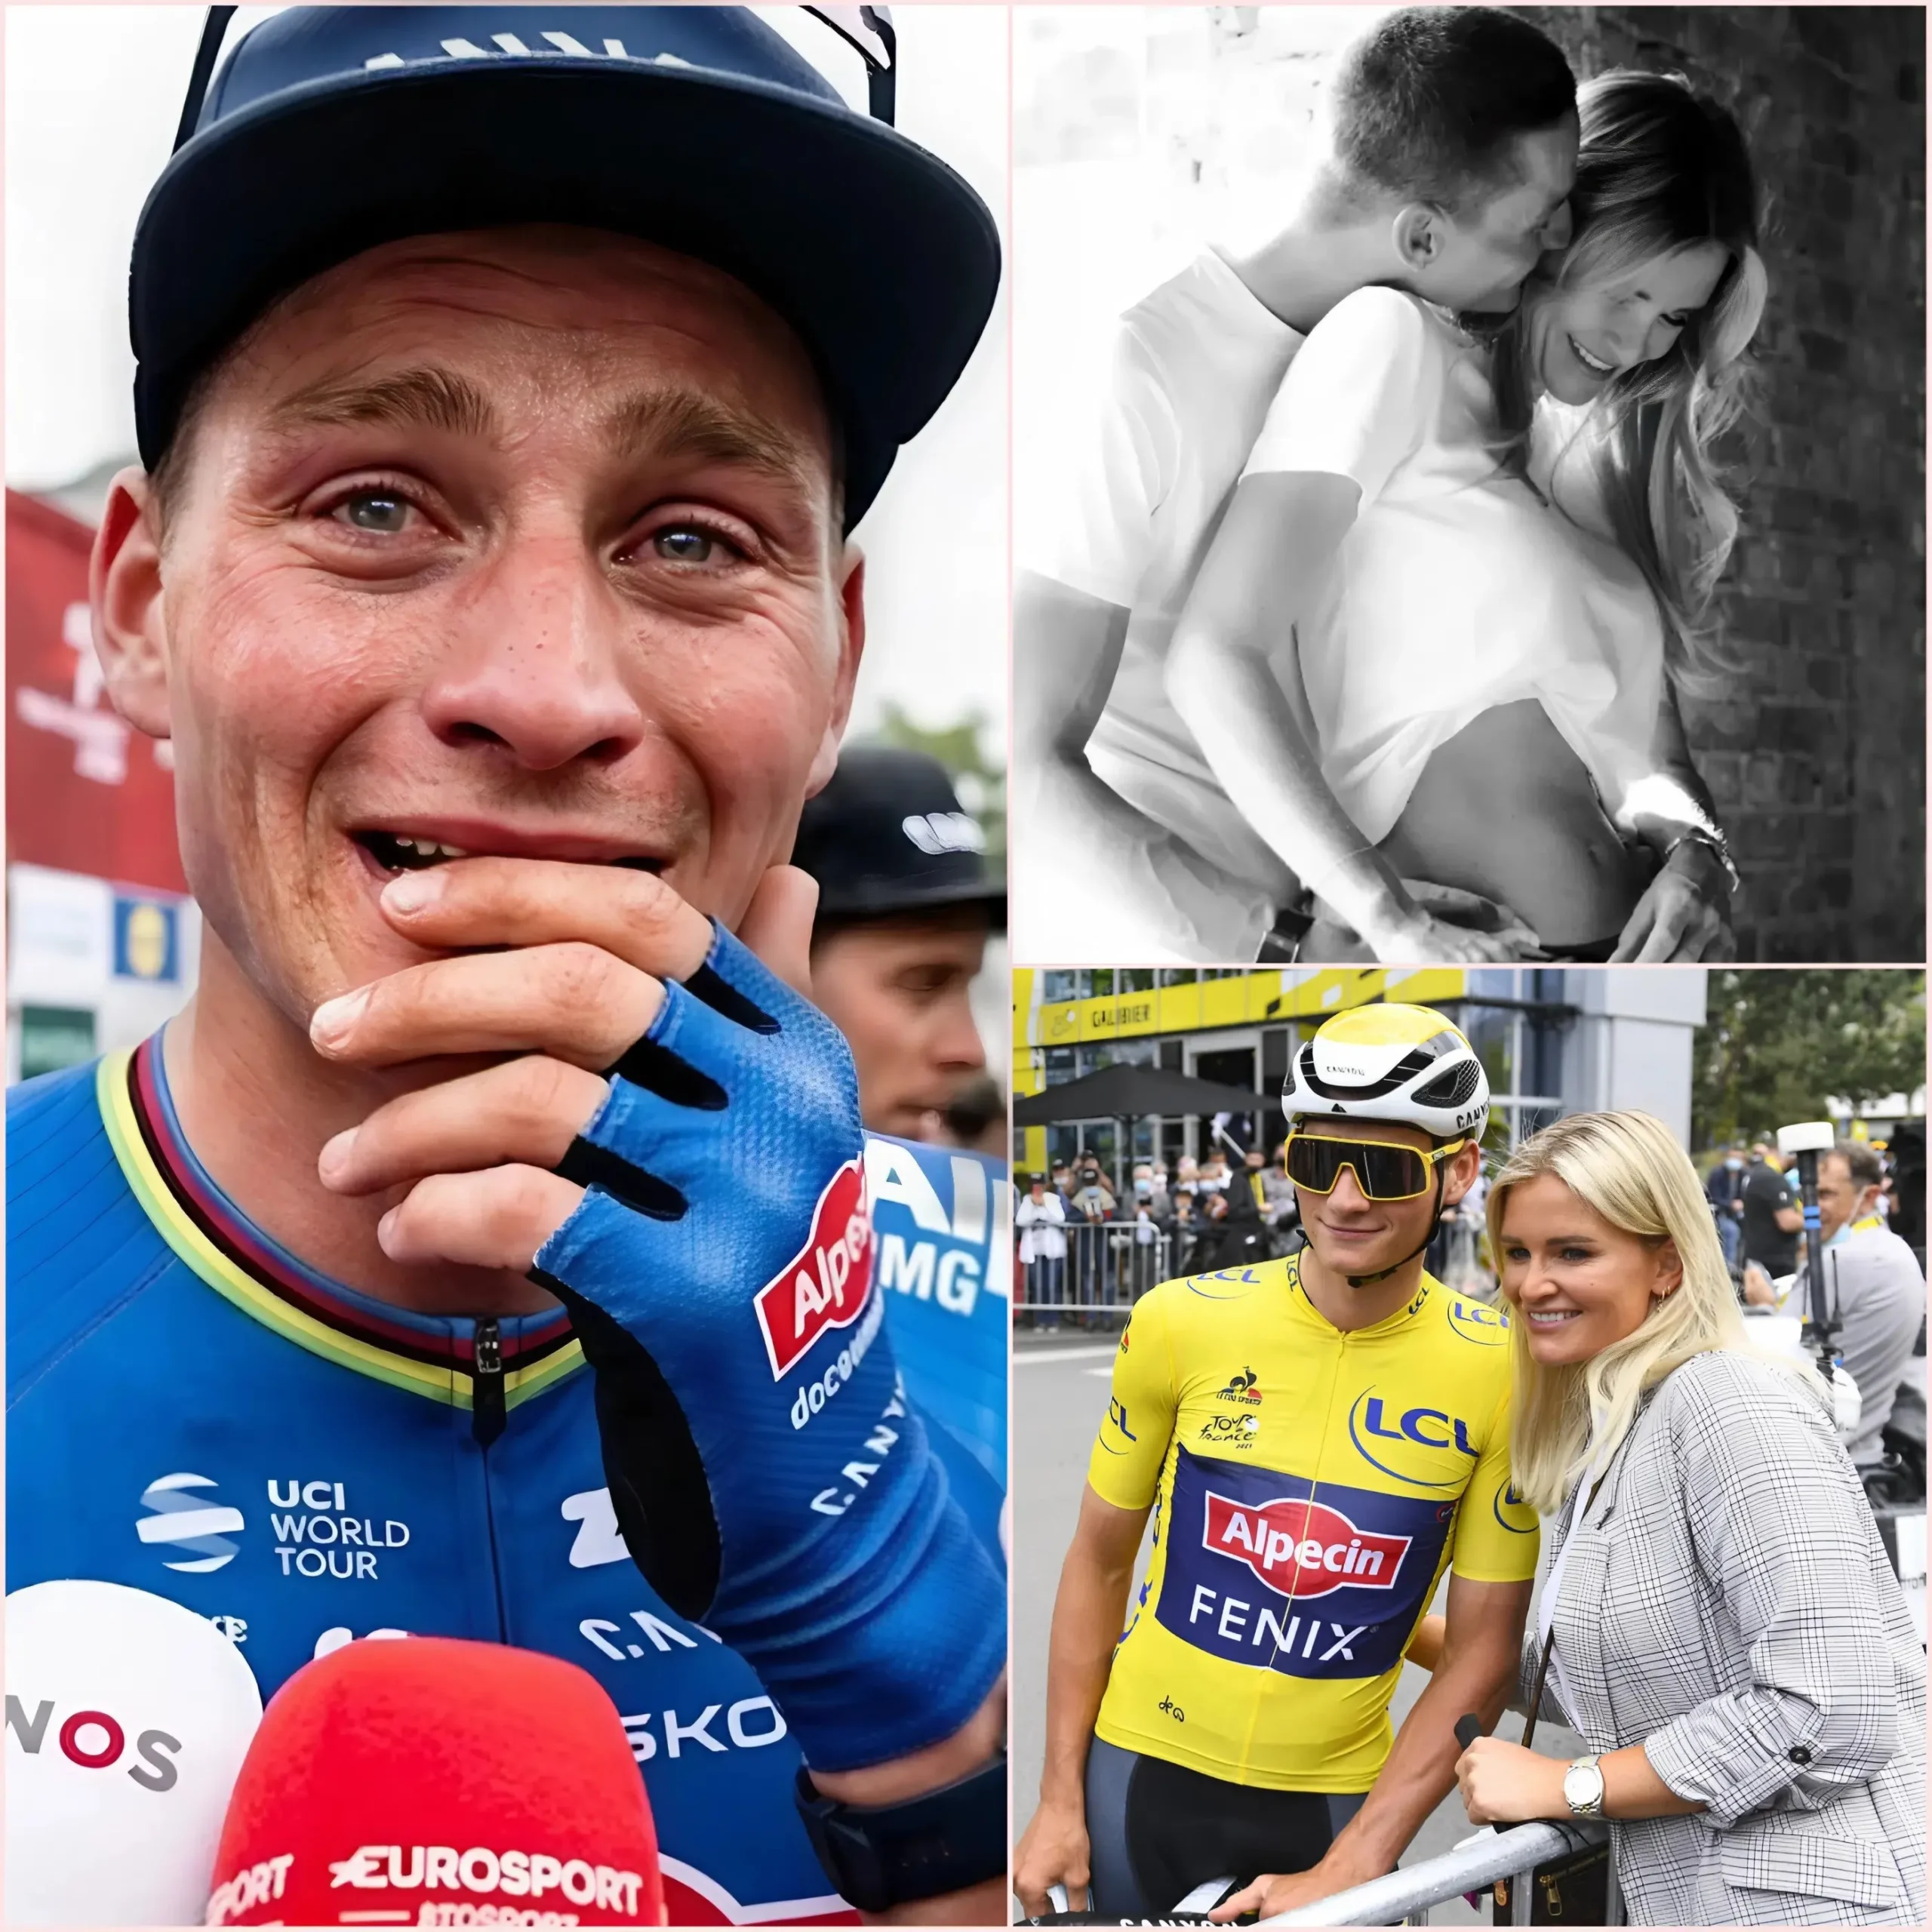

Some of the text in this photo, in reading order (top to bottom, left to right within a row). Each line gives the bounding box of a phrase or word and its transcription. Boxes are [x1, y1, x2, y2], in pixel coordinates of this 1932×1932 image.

[1364, 1397, 1480, 1458] LCL
[267, 1479, 346, 1511] UCI
[270, 1513, 411, 1548] WORLD
[1221, 1512, 1385, 1576] Alpecin
[274, 1547, 379, 1580] TOUR
[1189, 1583, 1369, 1661] FENIX
[329, 1844, 644, 1917] EUROSPORT
